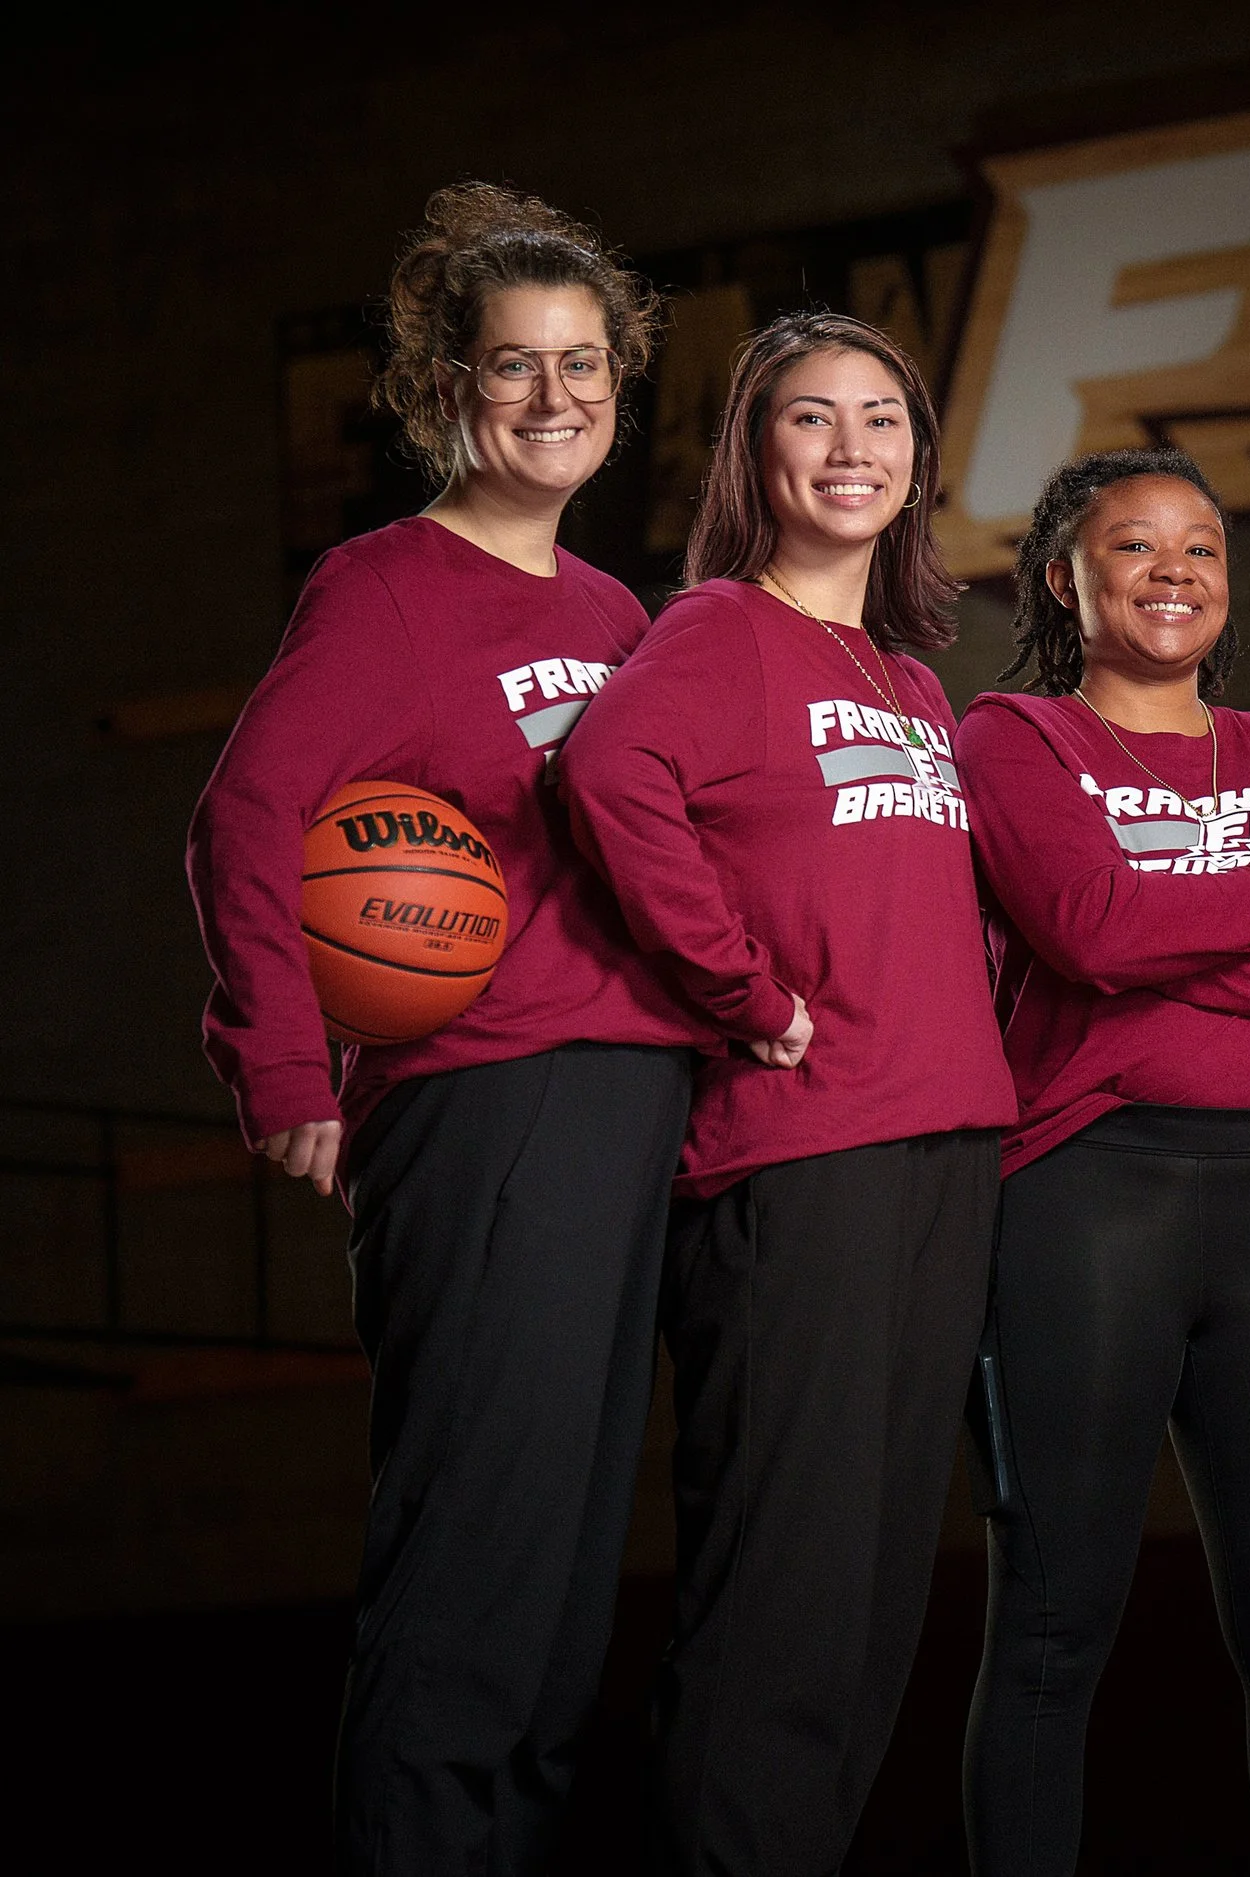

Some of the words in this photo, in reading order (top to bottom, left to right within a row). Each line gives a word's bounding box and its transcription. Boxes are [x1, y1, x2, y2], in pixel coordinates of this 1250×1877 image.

[496, 657, 621, 713] FRAN
[335, 810, 500, 878] Wilson
[359, 897, 500, 940] EVOLUTION
